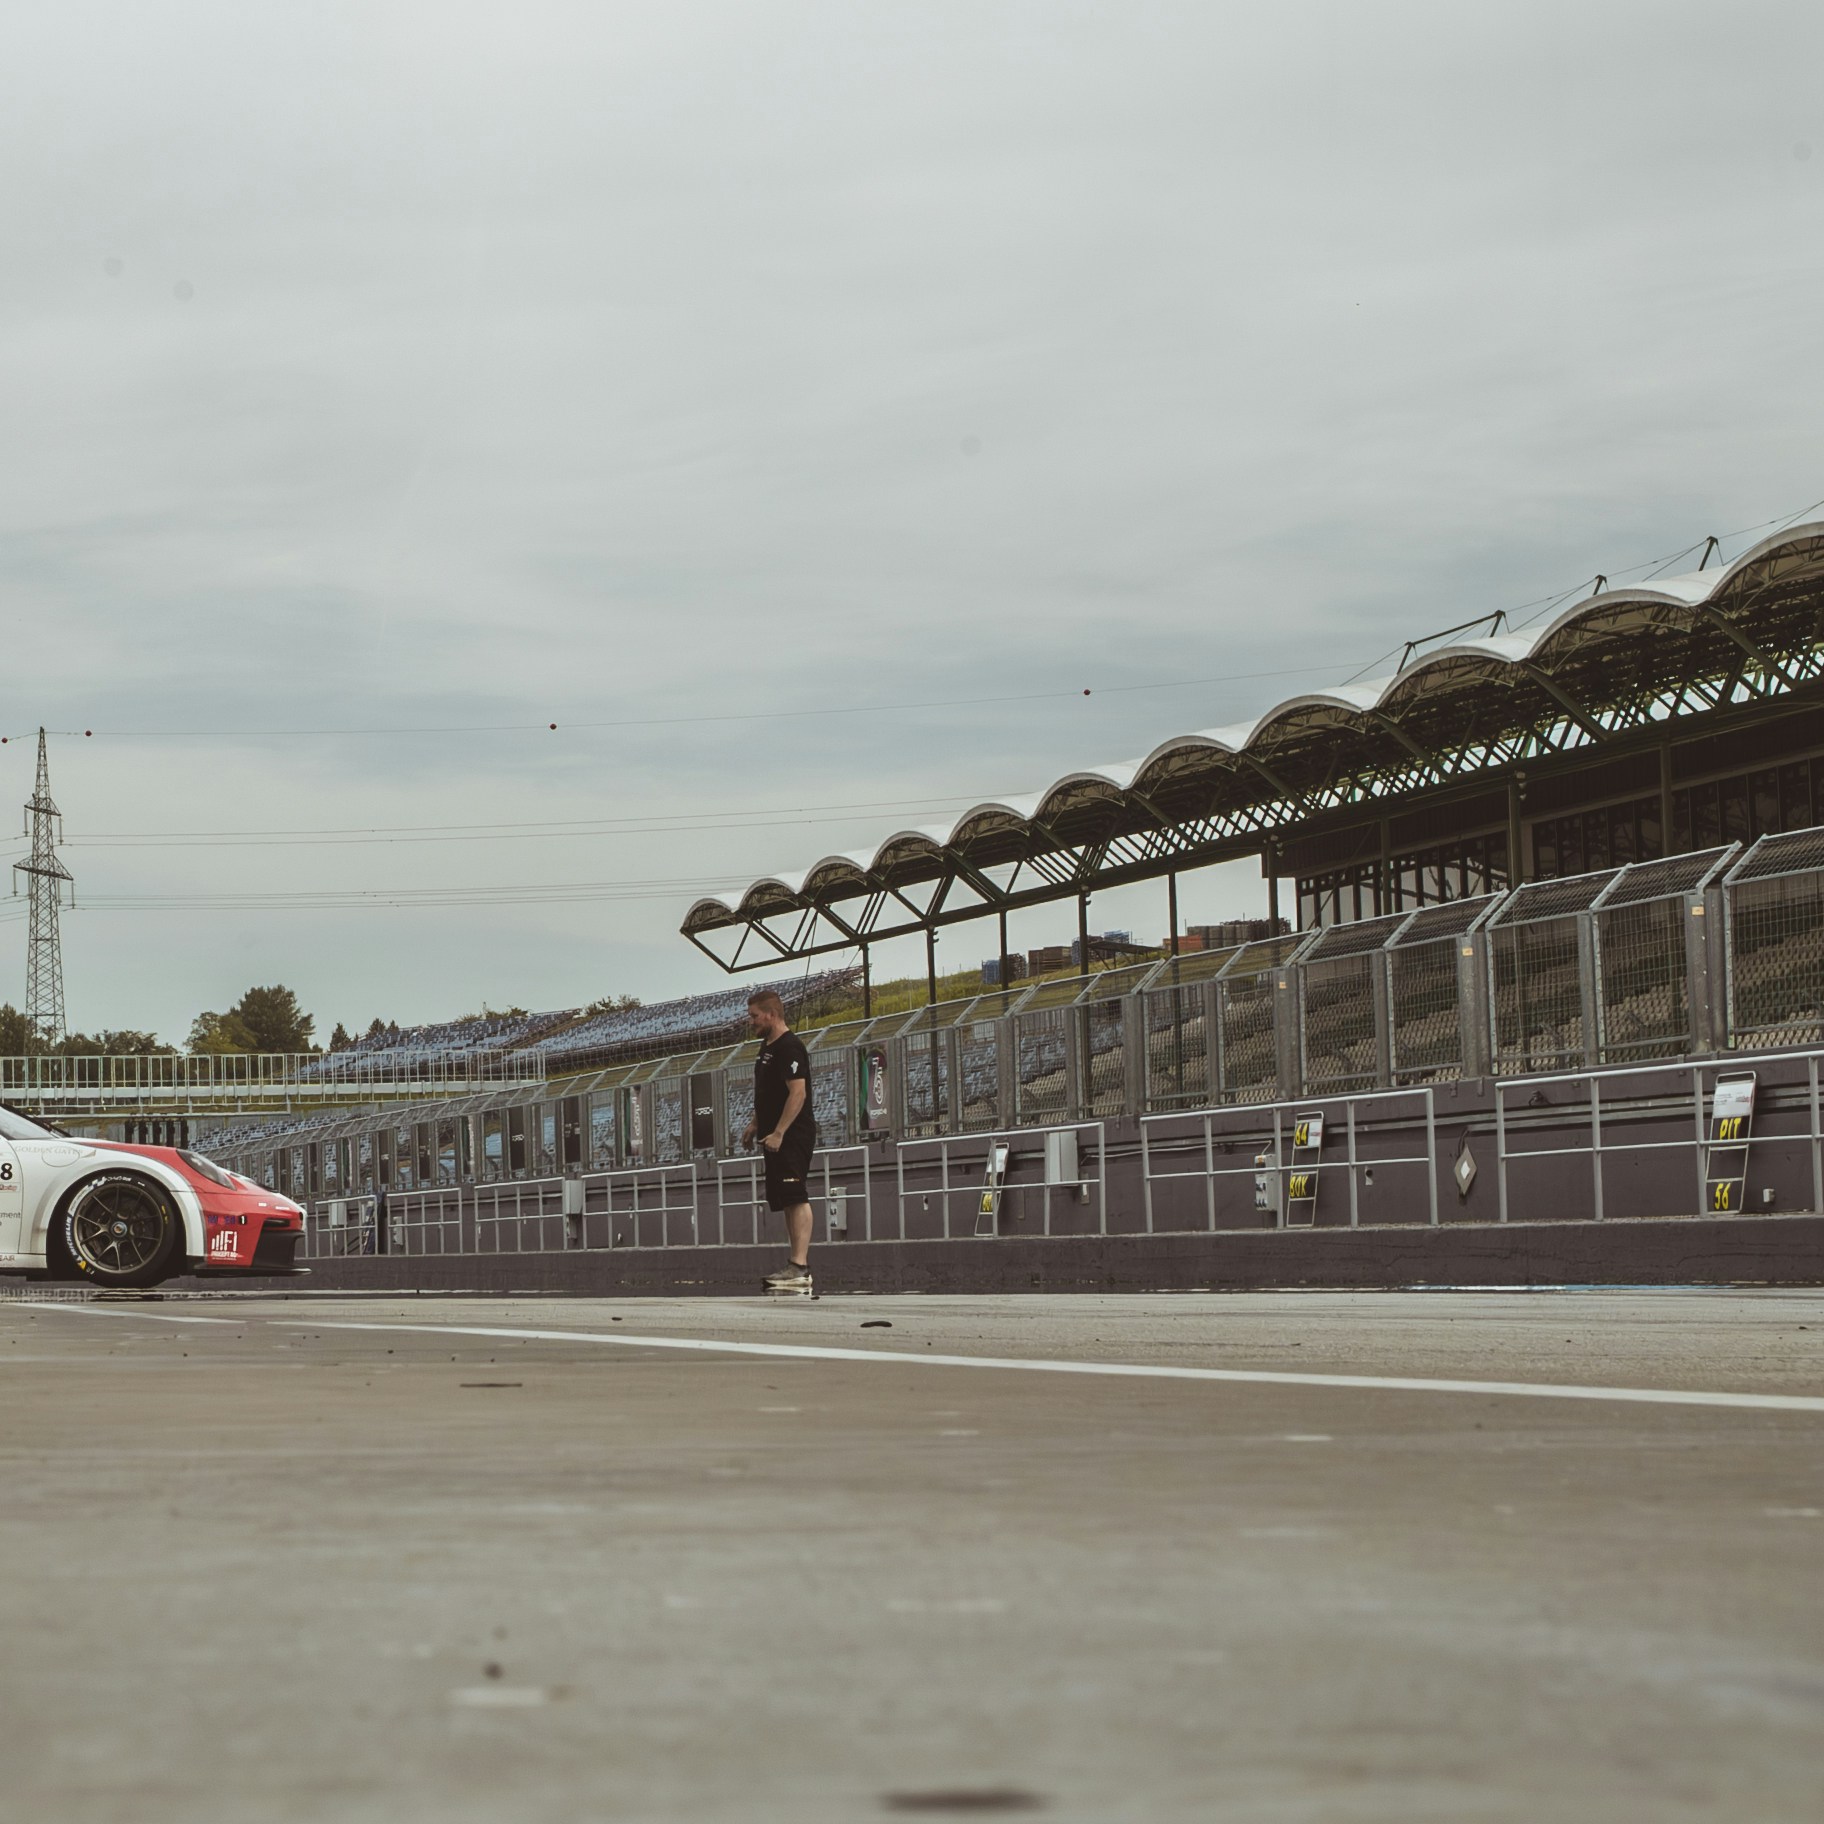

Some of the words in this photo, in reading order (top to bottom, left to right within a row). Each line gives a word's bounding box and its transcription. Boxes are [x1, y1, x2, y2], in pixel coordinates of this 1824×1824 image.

[1294, 1122, 1309, 1146] 64
[1719, 1117, 1742, 1140] PIT
[1714, 1183, 1732, 1210] 56
